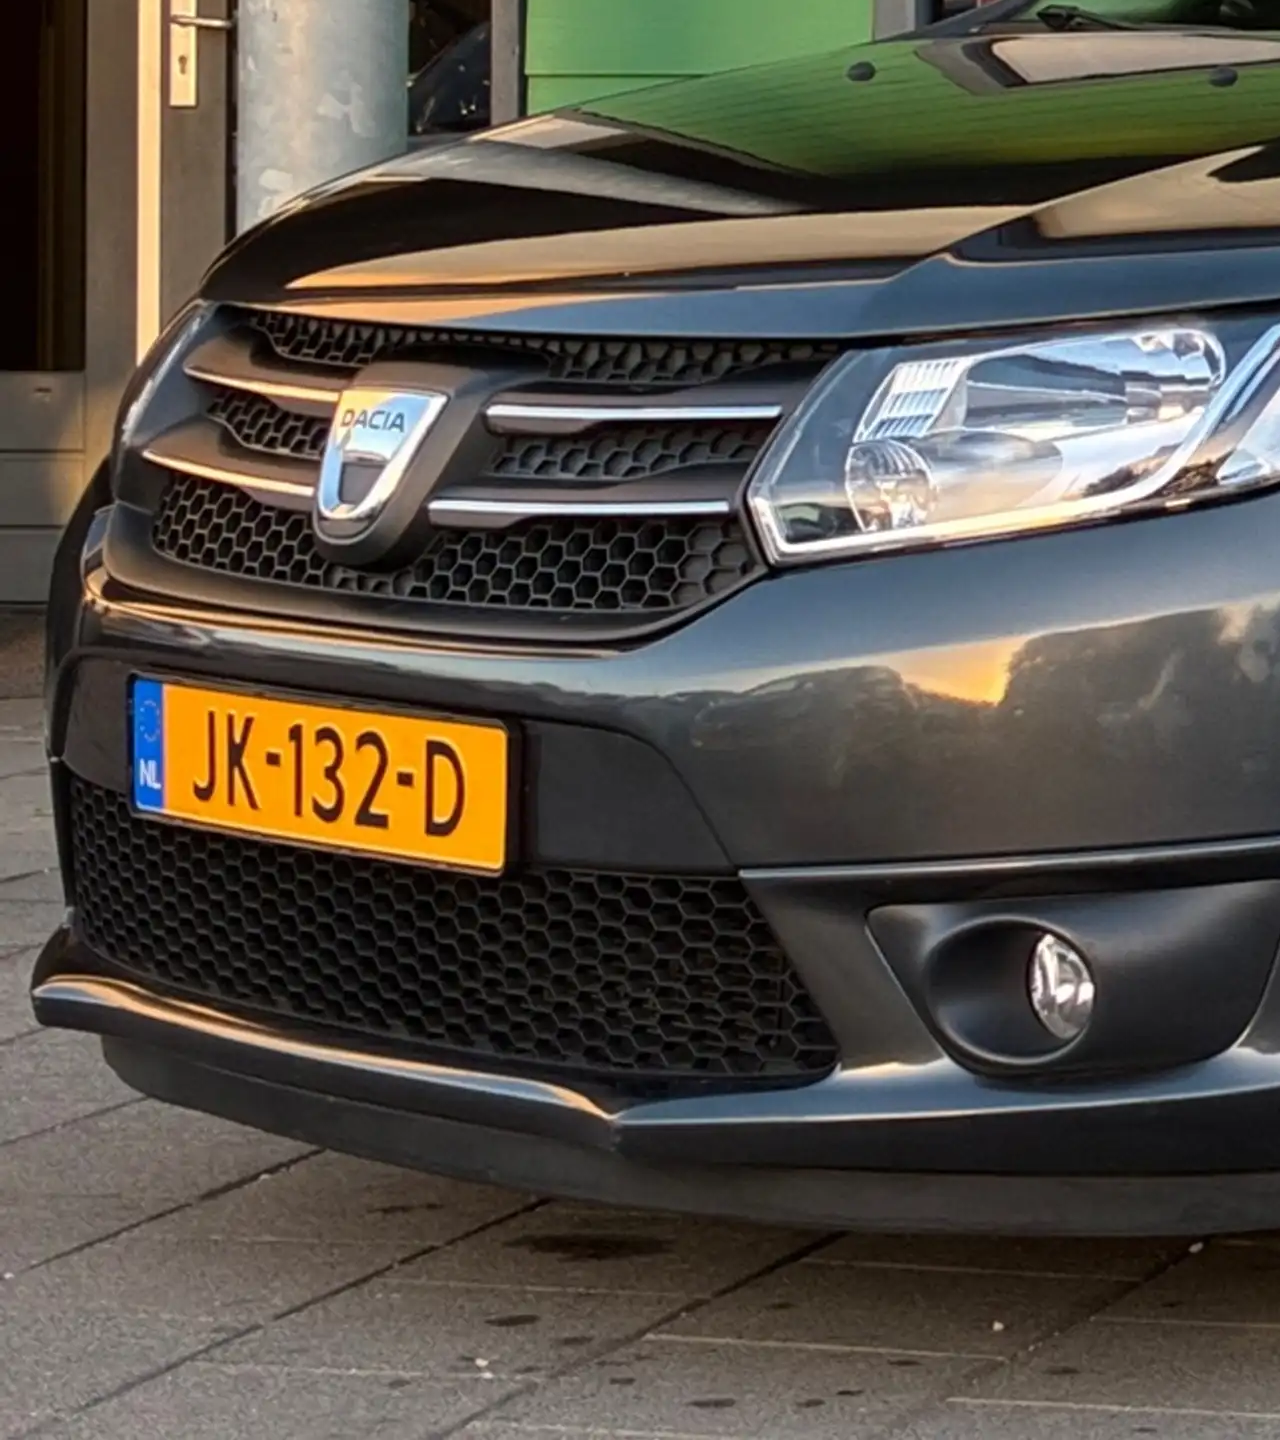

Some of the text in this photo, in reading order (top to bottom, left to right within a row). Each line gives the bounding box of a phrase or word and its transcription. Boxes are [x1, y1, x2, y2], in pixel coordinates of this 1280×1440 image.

[339, 407, 406, 434] DACIA
[138, 758, 163, 790] NL
[192, 709, 466, 839] JK-132-D
